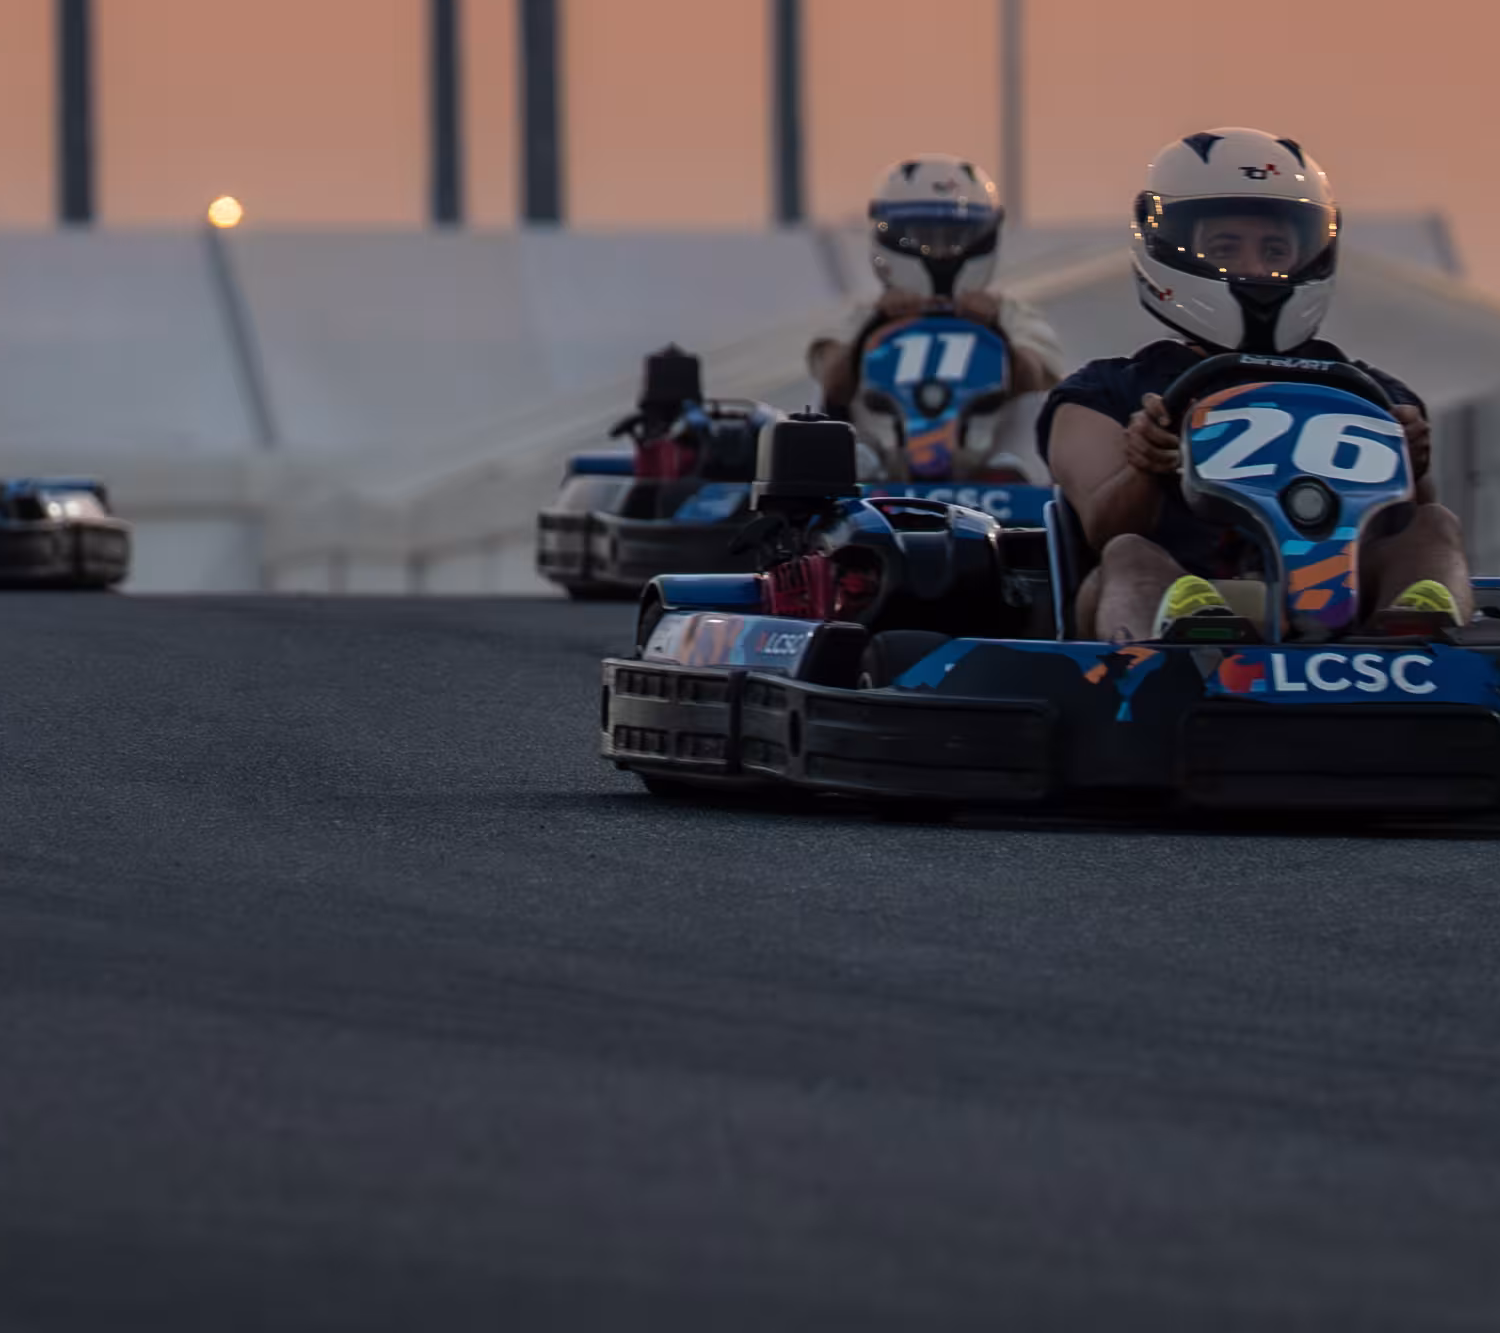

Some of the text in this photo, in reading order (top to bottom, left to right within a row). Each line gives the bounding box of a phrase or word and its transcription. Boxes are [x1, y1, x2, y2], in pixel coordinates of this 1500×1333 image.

[892, 332, 977, 384] 11
[1196, 406, 1405, 484] 26
[1270, 652, 1438, 695] LCSC
